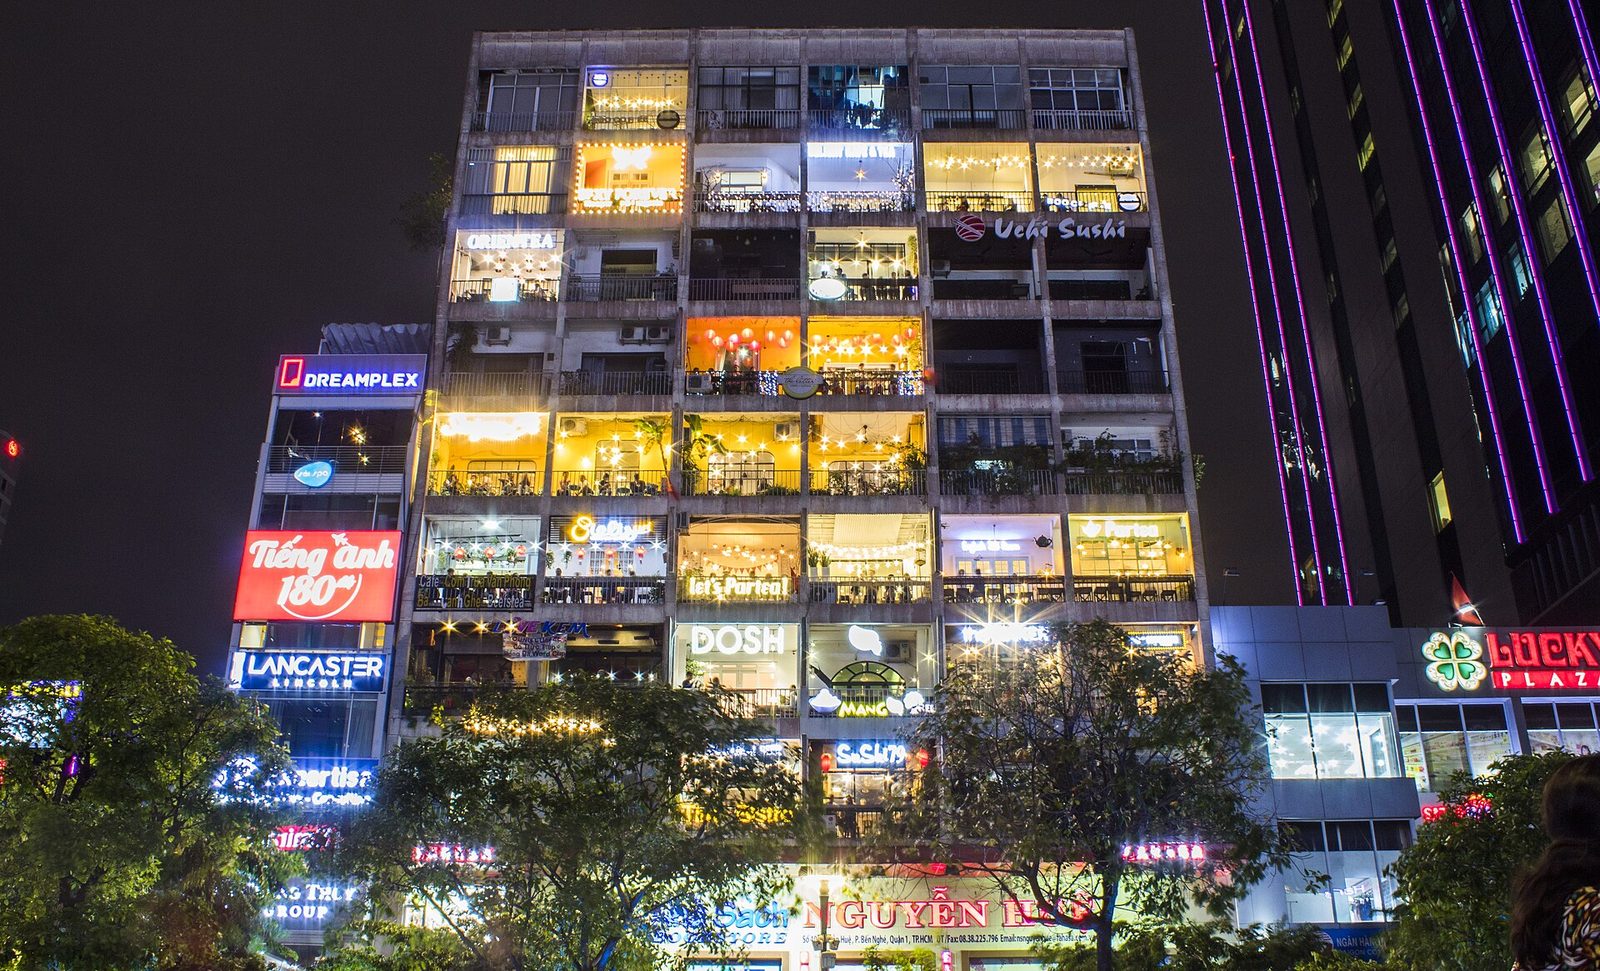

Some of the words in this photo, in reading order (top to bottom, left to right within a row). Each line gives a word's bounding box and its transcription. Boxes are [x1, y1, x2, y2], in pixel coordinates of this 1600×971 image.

[994, 217, 1048, 240] Uchi
[1058, 217, 1126, 240] Sushi
[304, 373, 418, 387] DREAMPLEX
[249, 534, 328, 577] Tiếng
[278, 574, 337, 606] 180
[691, 625, 784, 655] DOSH
[1485, 632, 1600, 668] LUCKY
[247, 654, 383, 677] LANCASTER
[1501, 671, 1600, 687] PLAZ
[803, 886, 989, 928] NGUYỄN
